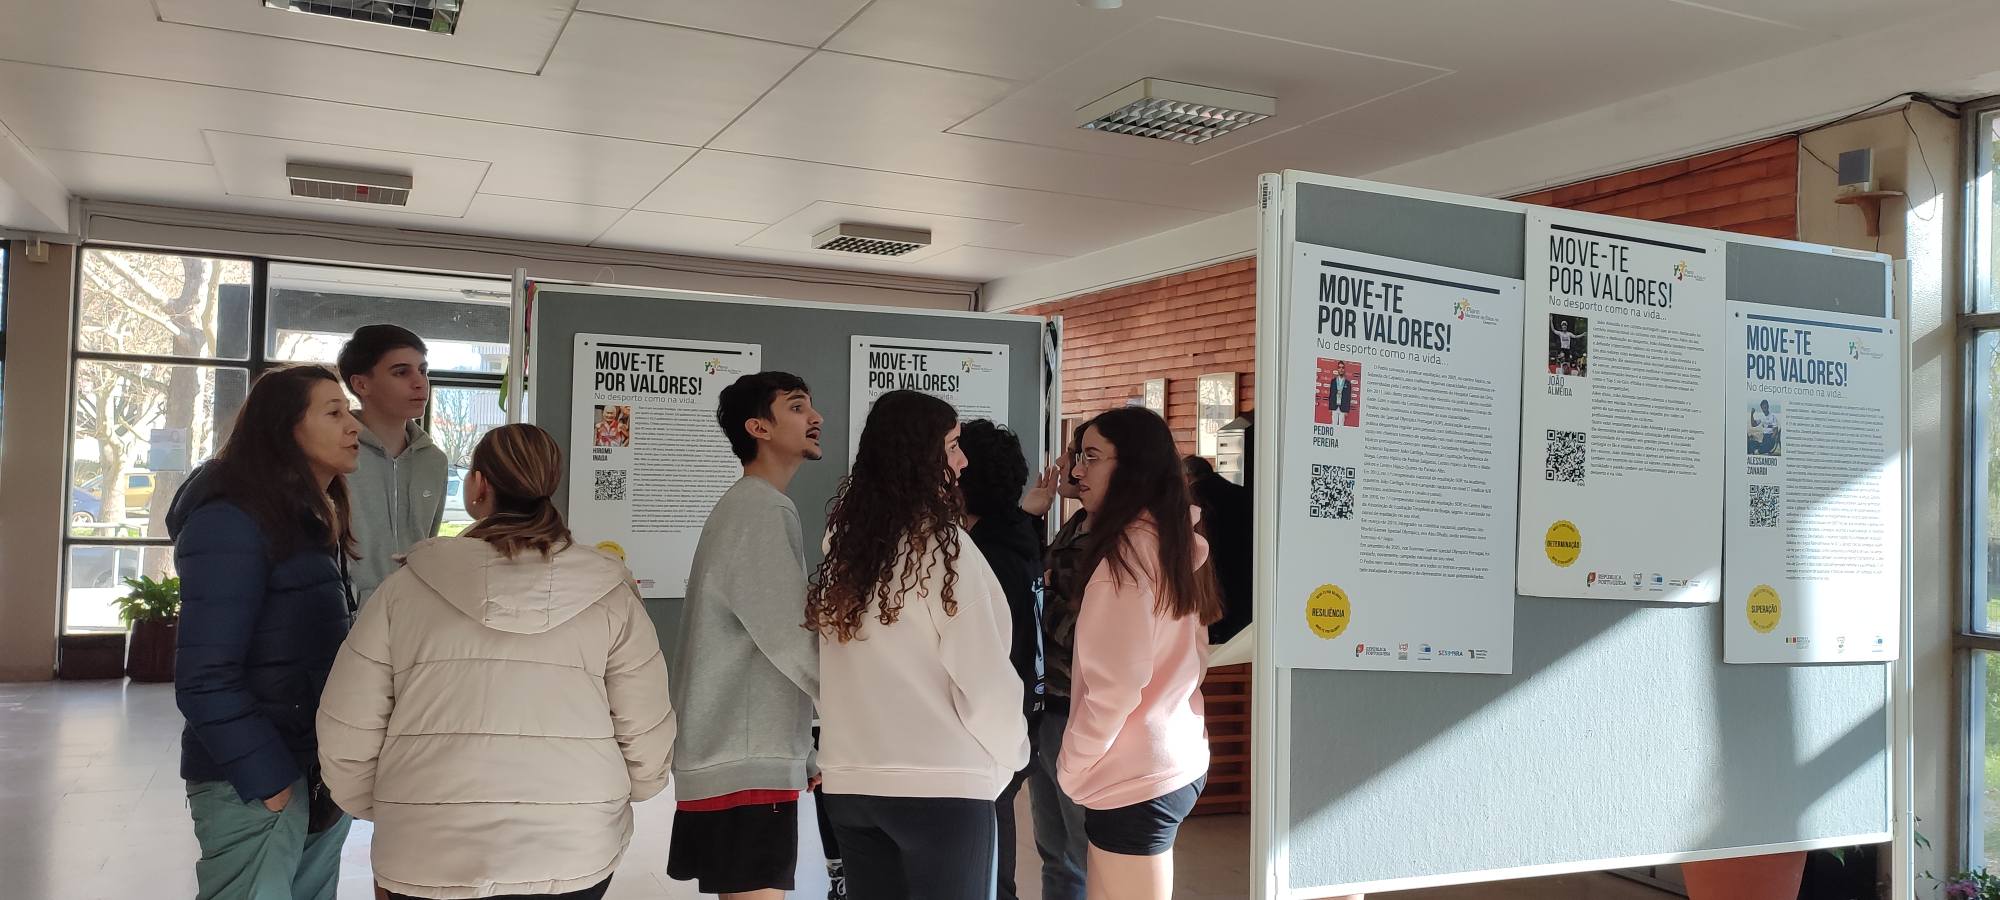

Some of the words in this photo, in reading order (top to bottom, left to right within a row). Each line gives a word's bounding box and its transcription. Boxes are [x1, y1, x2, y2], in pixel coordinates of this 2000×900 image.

[1550, 235, 1629, 273] MOVE-TE
[1319, 272, 1404, 314] MOVE-TE
[1550, 265, 1583, 296] POR
[1590, 270, 1673, 309] VALORES!
[1549, 296, 1561, 307] No
[1563, 298, 1603, 313] desporto
[1605, 304, 1629, 315] como
[1630, 307, 1641, 317] na
[1317, 305, 1357, 339] POR
[1363, 311, 1452, 352] VALORES!
[1316, 337, 1331, 350] No
[1333, 340, 1377, 356] desporto
[1379, 348, 1406, 361] como
[1408, 353, 1420, 362] na
[1746, 324, 1812, 356] MOVE-TE
[596, 350, 665, 373] MOVE-TE
[869, 351, 927, 372] MOVE-TE
[1746, 353, 1776, 381] POR
[1780, 356, 1848, 387] VALORES!
[594, 372, 625, 392] POR
[631, 374, 702, 395] VALORES!
[869, 371, 895, 390] POR
[899, 373, 959, 392] VALORES!
[1547, 375, 1565, 387] JOÃO
[1547, 386, 1573, 397] ALMEIDA
[1746, 381, 1757, 392] No
[1759, 383, 1793, 396] desporto
[1793, 387, 1815, 396] como
[1816, 389, 1825, 397] na
[594, 393, 606, 401] No
[607, 393, 643, 403] desporto
[644, 395, 666, 403] como
[1313, 425, 1334, 437] PEDRO
[1312, 436, 1339, 448] PEREIRA
[1746, 456, 1778, 466] ALESSANDRO
[1311, 607, 1345, 617] RESILIÊNCIA
[1751, 603, 1778, 615] SUPERAÇÃO
